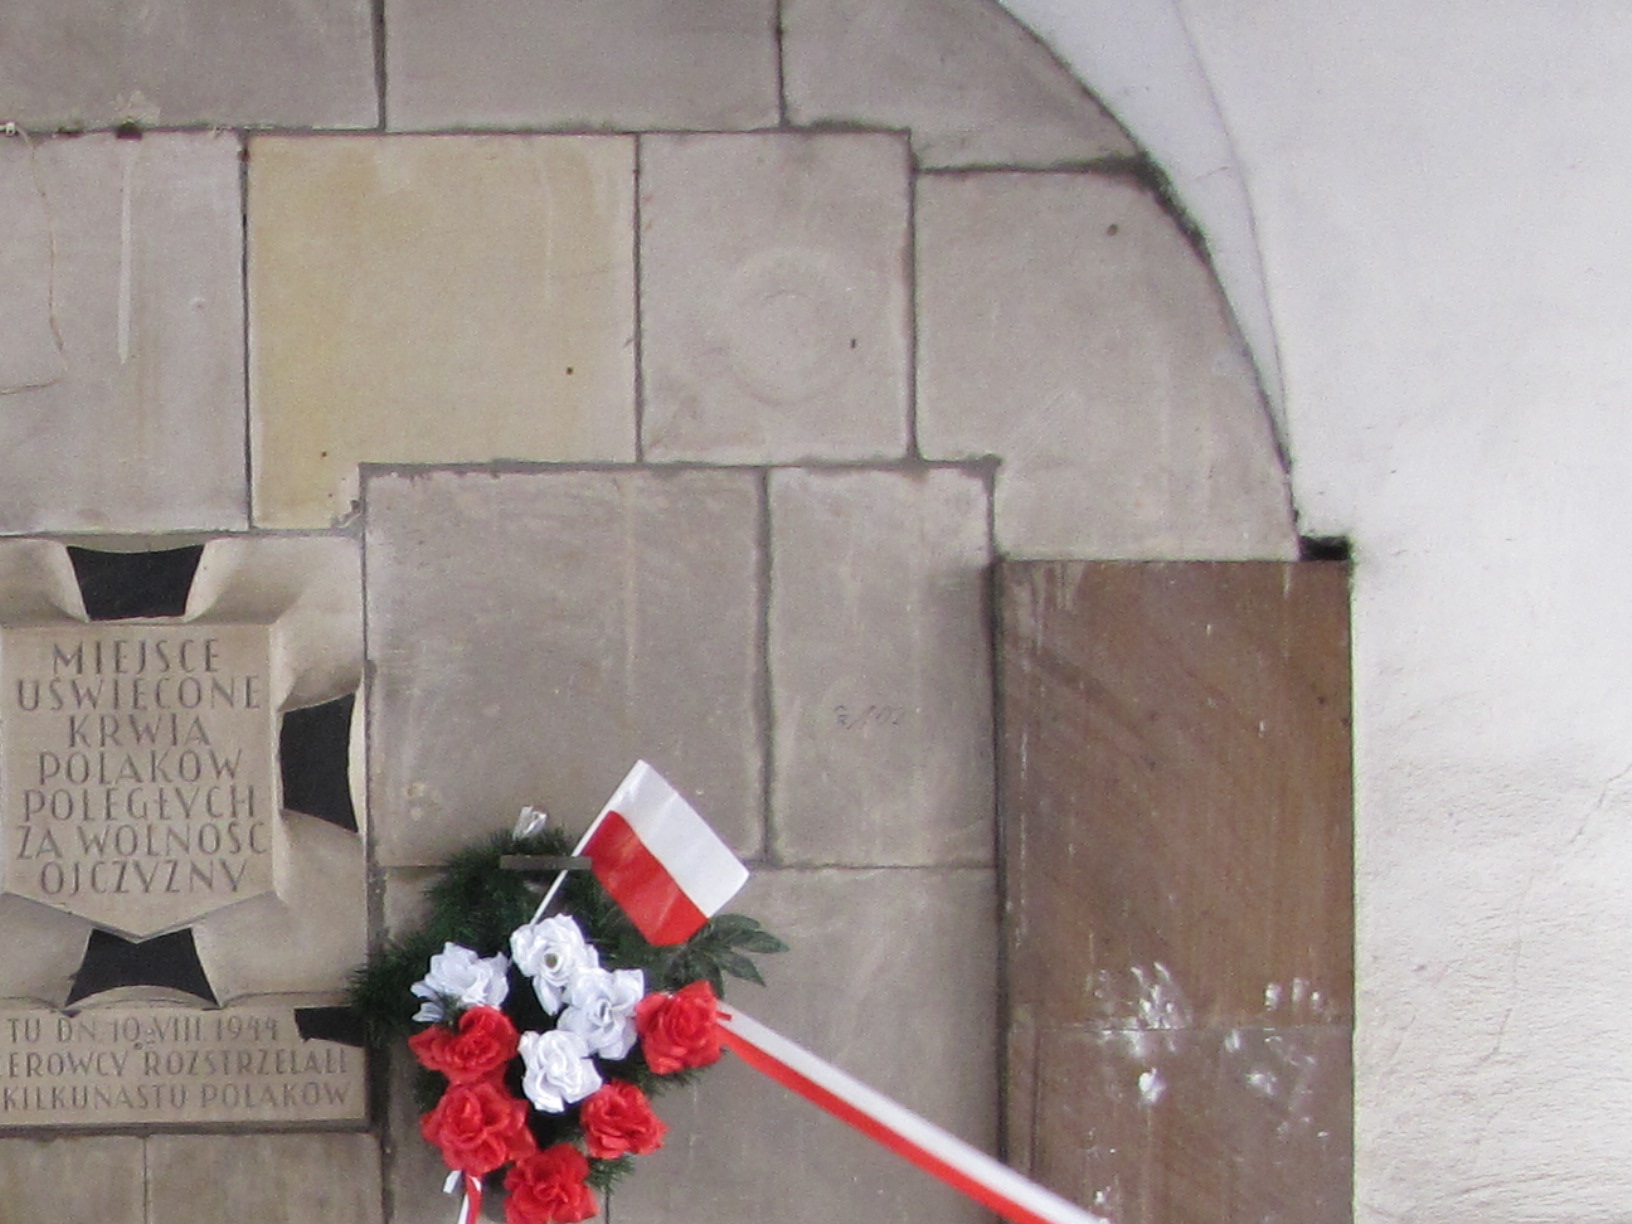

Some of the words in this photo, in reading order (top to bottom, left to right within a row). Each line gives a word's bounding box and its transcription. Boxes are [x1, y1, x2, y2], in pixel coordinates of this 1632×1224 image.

[52, 639, 220, 676] MIEJSCE
[23, 784, 256, 822] POLEGŁYCH
[16, 825, 64, 860] ZA
[39, 857, 248, 896] OJCZYZNY
[7, 1017, 41, 1044] TU
[143, 1047, 348, 1078] ROZSTRZELALI
[3, 1082, 187, 1112] KILKUNASTU
